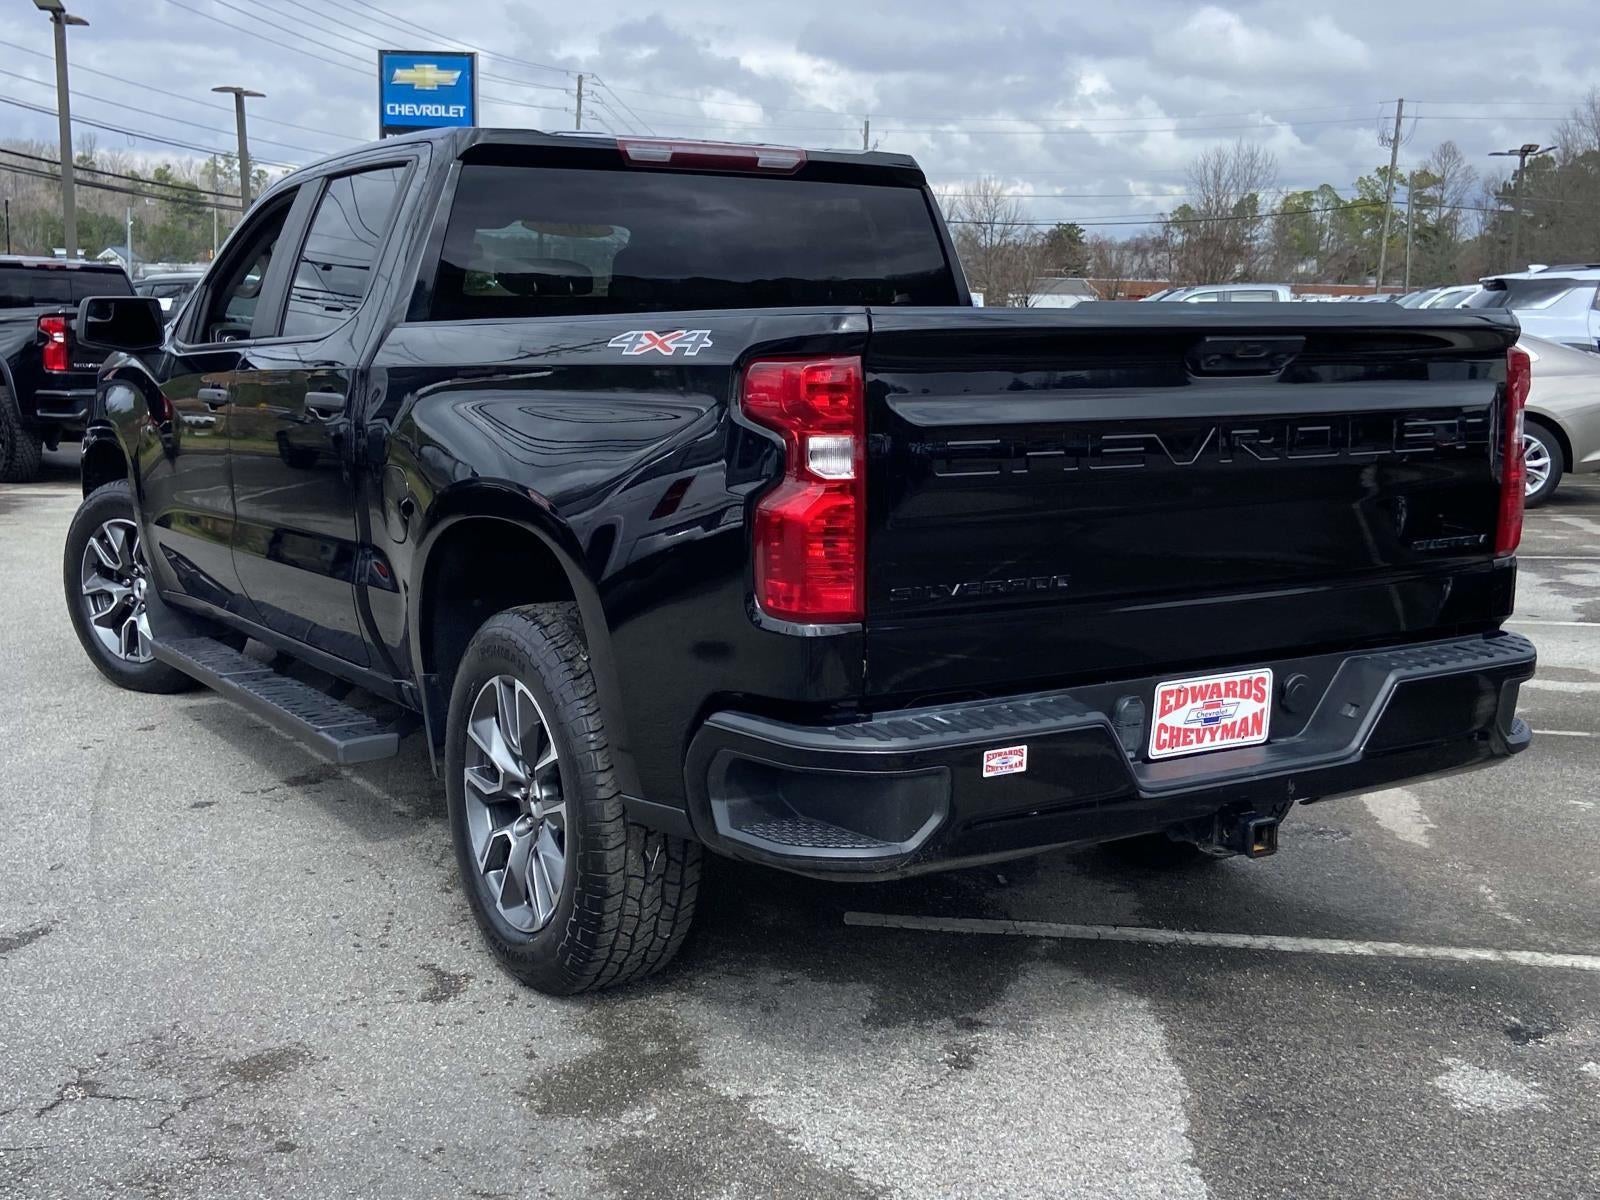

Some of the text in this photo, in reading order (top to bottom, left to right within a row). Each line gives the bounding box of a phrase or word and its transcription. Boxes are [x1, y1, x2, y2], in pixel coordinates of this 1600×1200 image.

[386, 103, 467, 118] CHEVROLET
[607, 329, 713, 356] 4X4
[935, 418, 1485, 477] CHEVROLET
[1158, 676, 1267, 719] EDWARDS
[1196, 708, 1229, 719] Chevrolet
[1155, 707, 1265, 751] CHEVYMAN
[985, 758, 1024, 773] CHEVYMAN
[986, 748, 1025, 762] EDWARDS
